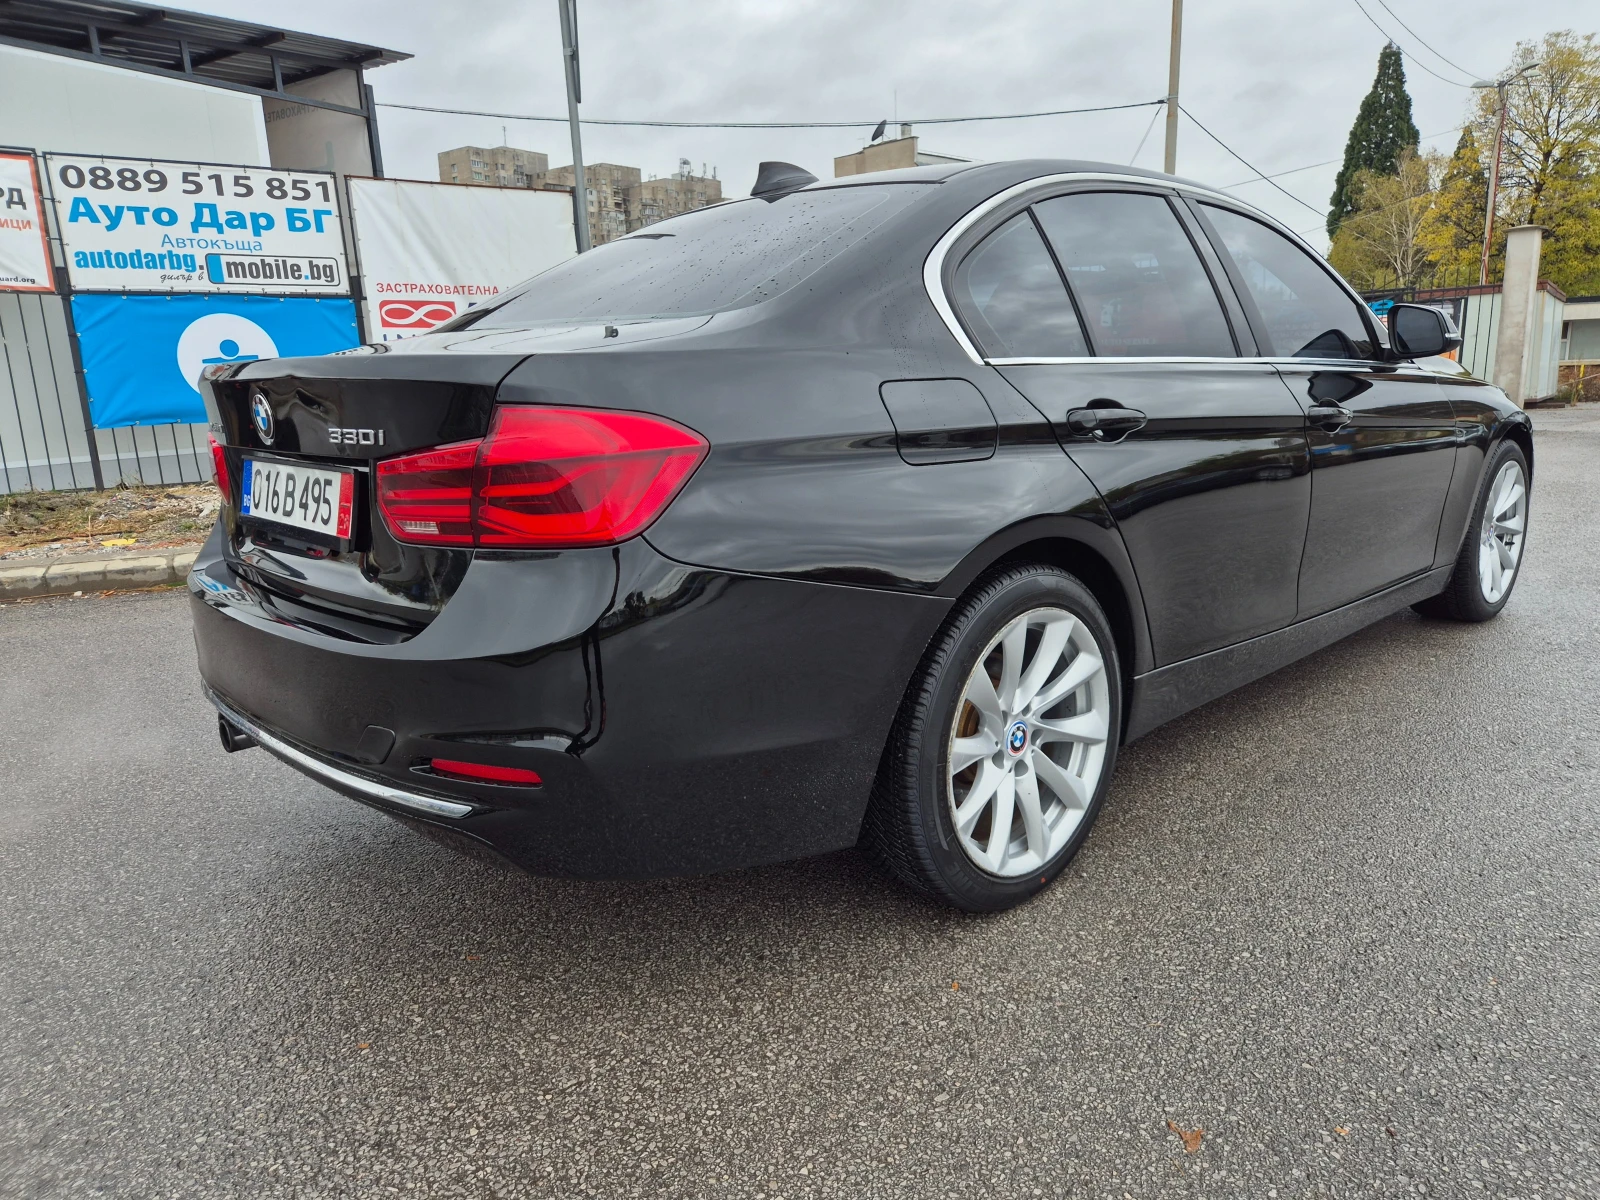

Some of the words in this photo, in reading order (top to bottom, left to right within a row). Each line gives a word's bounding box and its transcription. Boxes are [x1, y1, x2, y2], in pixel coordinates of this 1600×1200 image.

[59, 164, 168, 192] 0889
[182, 171, 254, 198] 515
[265, 177, 331, 203] 851
[68, 196, 179, 231] Ауто
[190, 202, 275, 237] Дар
[286, 207, 332, 233] БГ
[160, 233, 263, 253] Автокъща
[225, 258, 335, 283] mobile.bg
[376, 282, 499, 296] ЗАСТРАХОВАТЕЛНА
[328, 427, 386, 446] 330i
